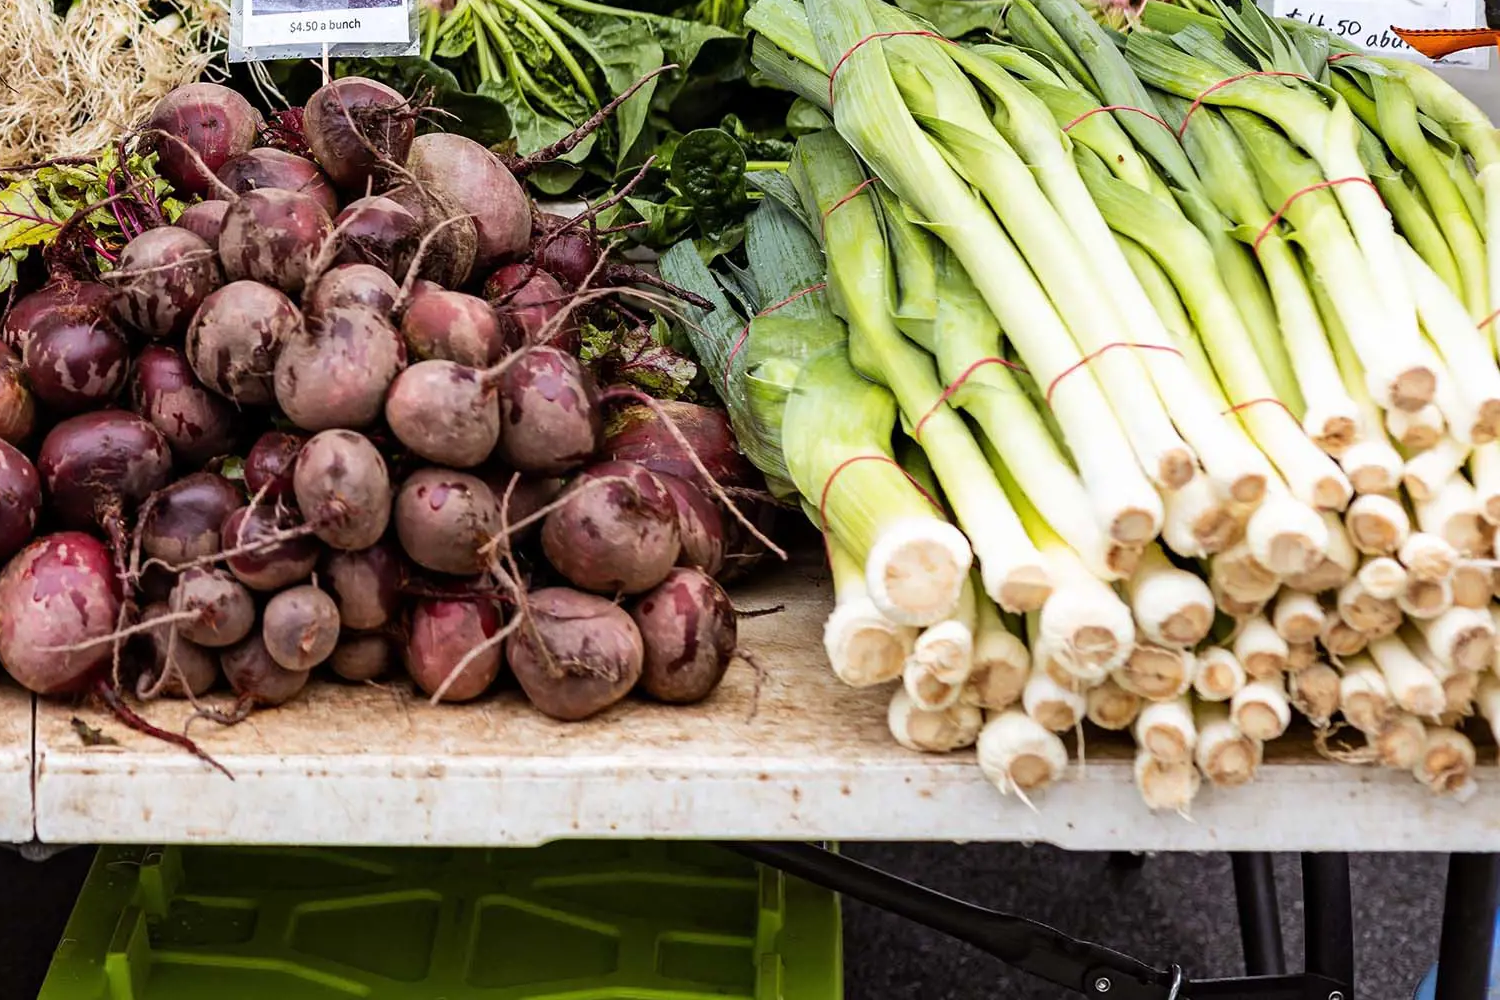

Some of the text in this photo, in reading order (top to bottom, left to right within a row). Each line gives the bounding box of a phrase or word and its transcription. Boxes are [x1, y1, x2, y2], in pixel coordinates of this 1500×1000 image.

[290, 18, 361, 33] $4.50 a bunch
